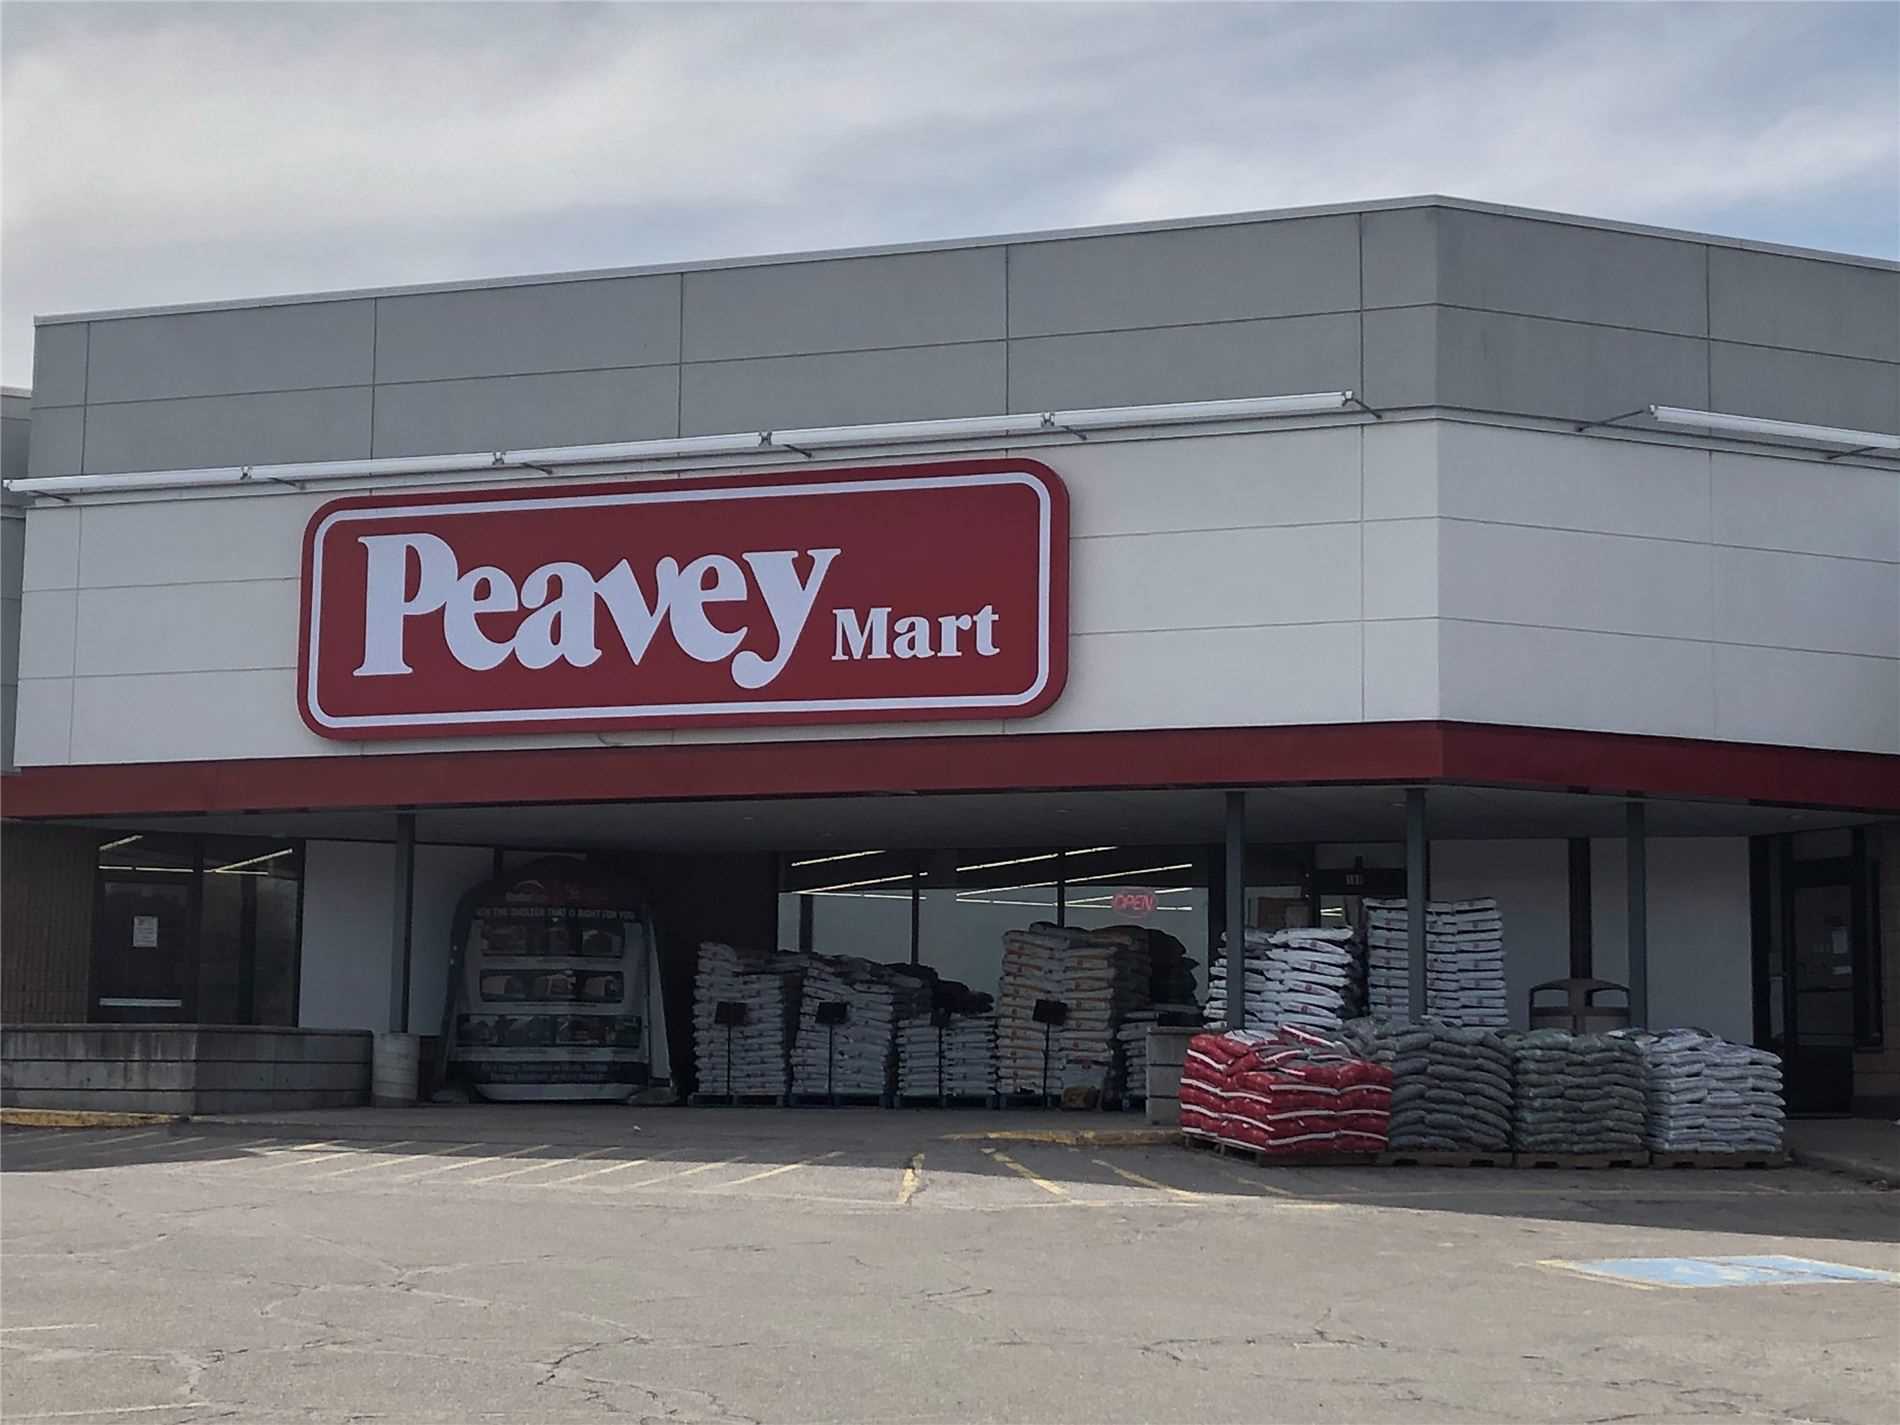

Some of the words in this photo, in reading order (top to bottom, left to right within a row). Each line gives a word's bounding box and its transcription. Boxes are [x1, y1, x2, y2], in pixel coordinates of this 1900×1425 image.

[353, 532, 842, 690] Peavey
[832, 604, 1001, 662] Mart
[1115, 894, 1153, 911] OPEN
